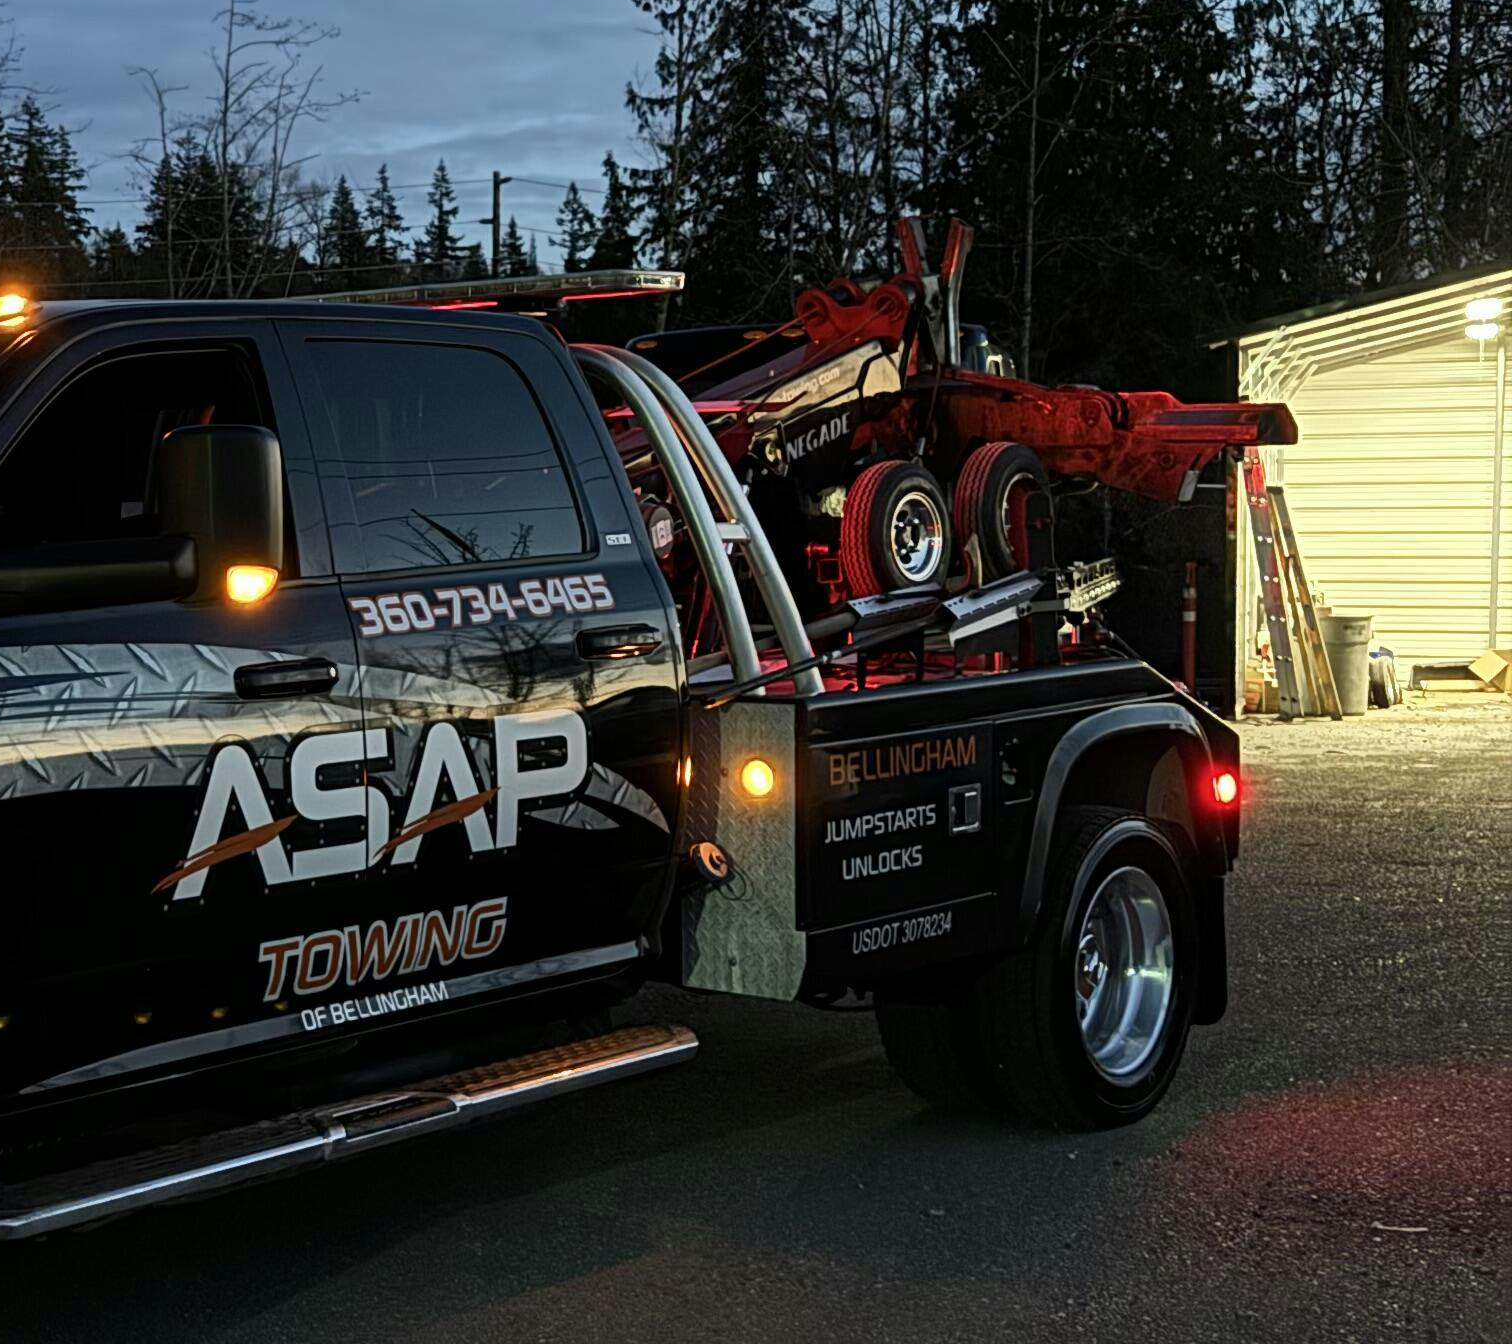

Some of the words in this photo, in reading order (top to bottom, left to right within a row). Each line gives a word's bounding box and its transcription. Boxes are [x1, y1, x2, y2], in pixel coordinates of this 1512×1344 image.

[351, 574, 615, 637] 360-734-6465
[829, 735, 977, 786] BELLINGHAM
[171, 709, 589, 902] ASAP
[824, 804, 937, 844] JUMPSTARTS
[842, 845, 923, 881] UNLOCKS
[258, 896, 508, 1003] TOWING
[852, 922, 901, 955] USDOT
[901, 910, 952, 944] 3078234
[300, 1006, 326, 1031] OF
[330, 980, 449, 1025] BELLINGHAM
